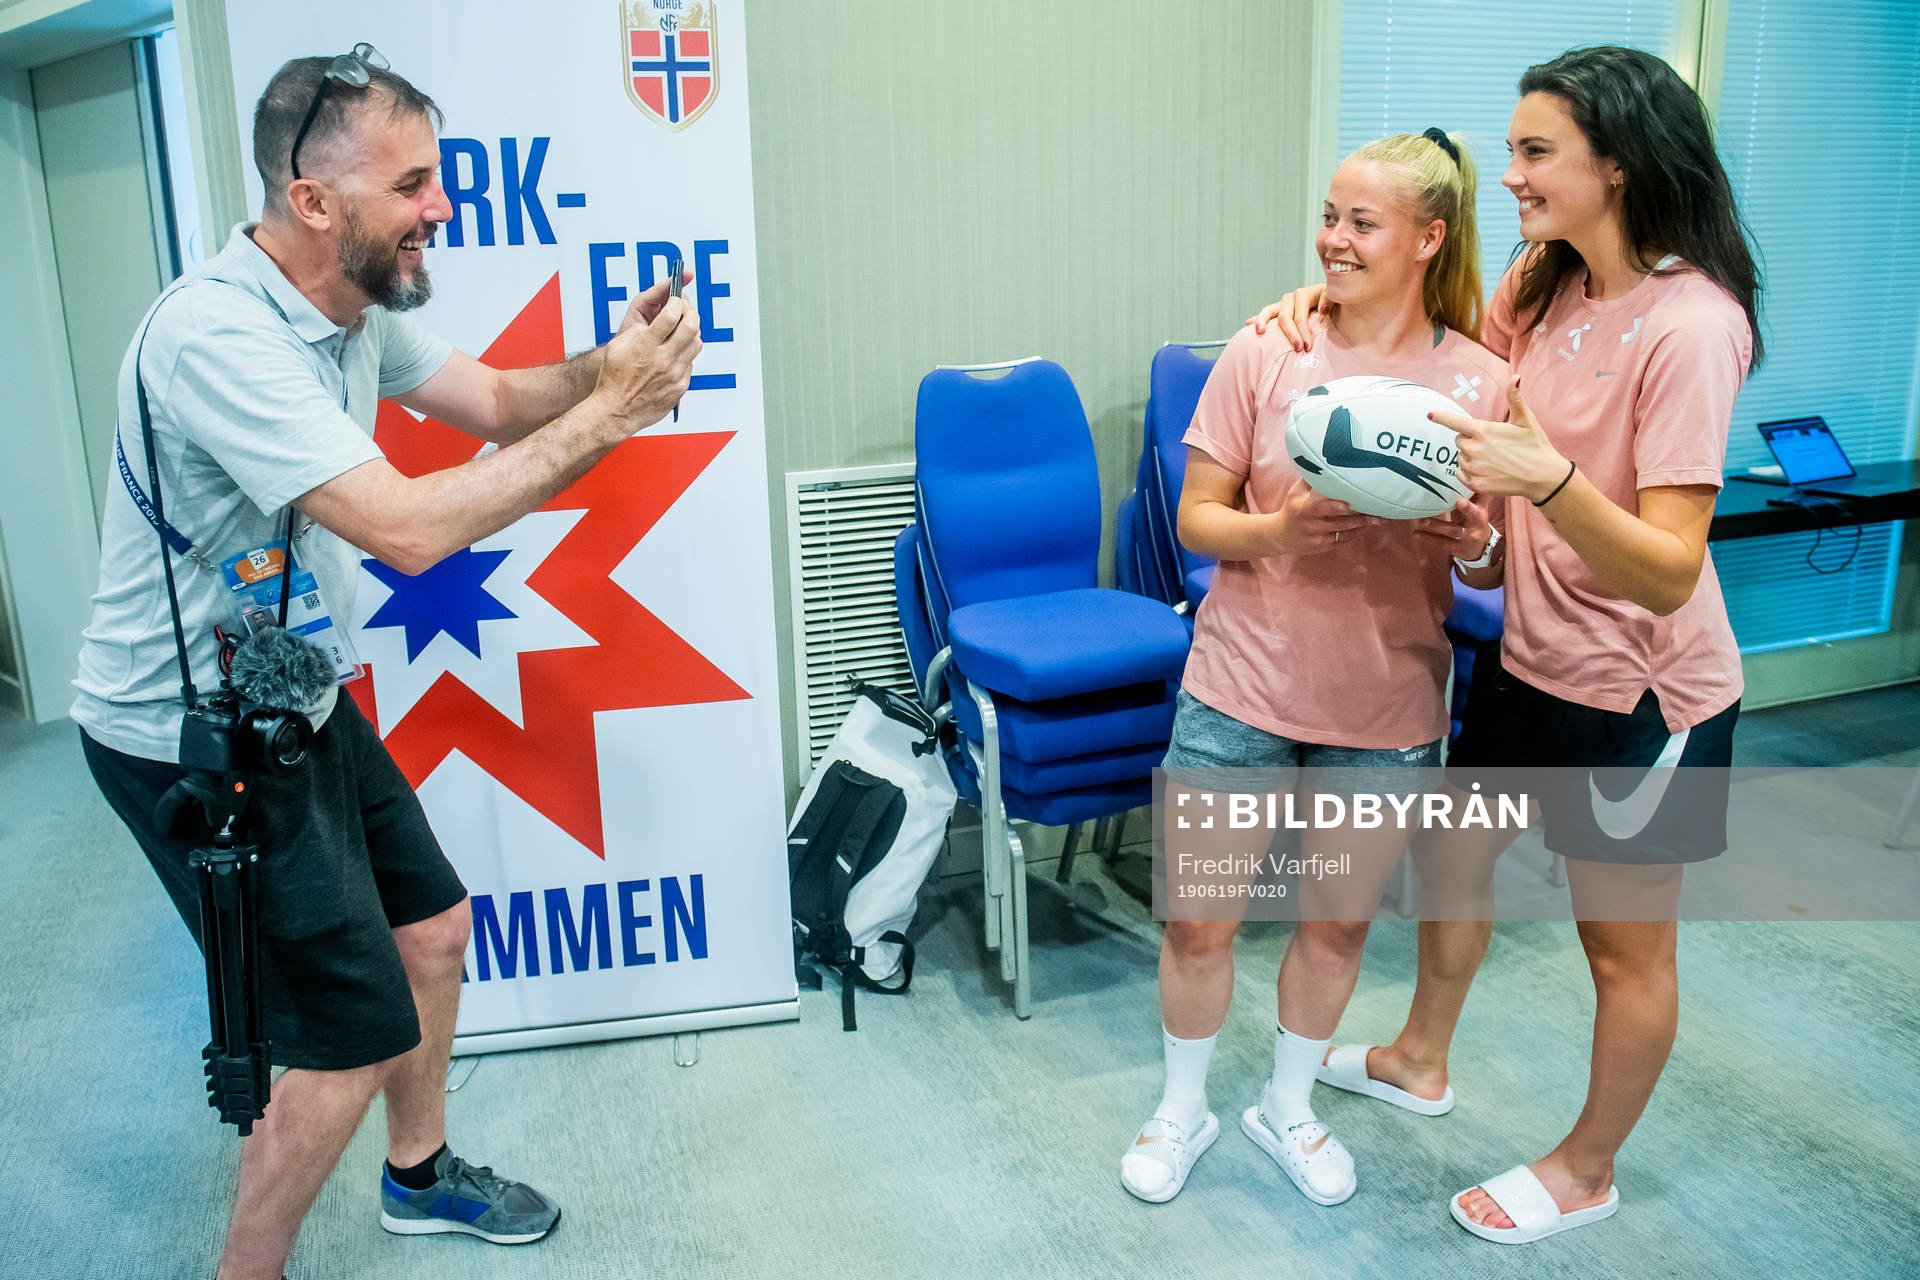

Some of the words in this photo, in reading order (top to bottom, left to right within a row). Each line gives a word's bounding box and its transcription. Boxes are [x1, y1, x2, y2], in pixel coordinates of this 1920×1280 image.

[653, 0, 682, 10] NORGE
[427, 137, 586, 248] RK-
[119, 461, 145, 504] FRANCE
[253, 556, 266, 566] 26
[460, 873, 709, 983] MMEN
